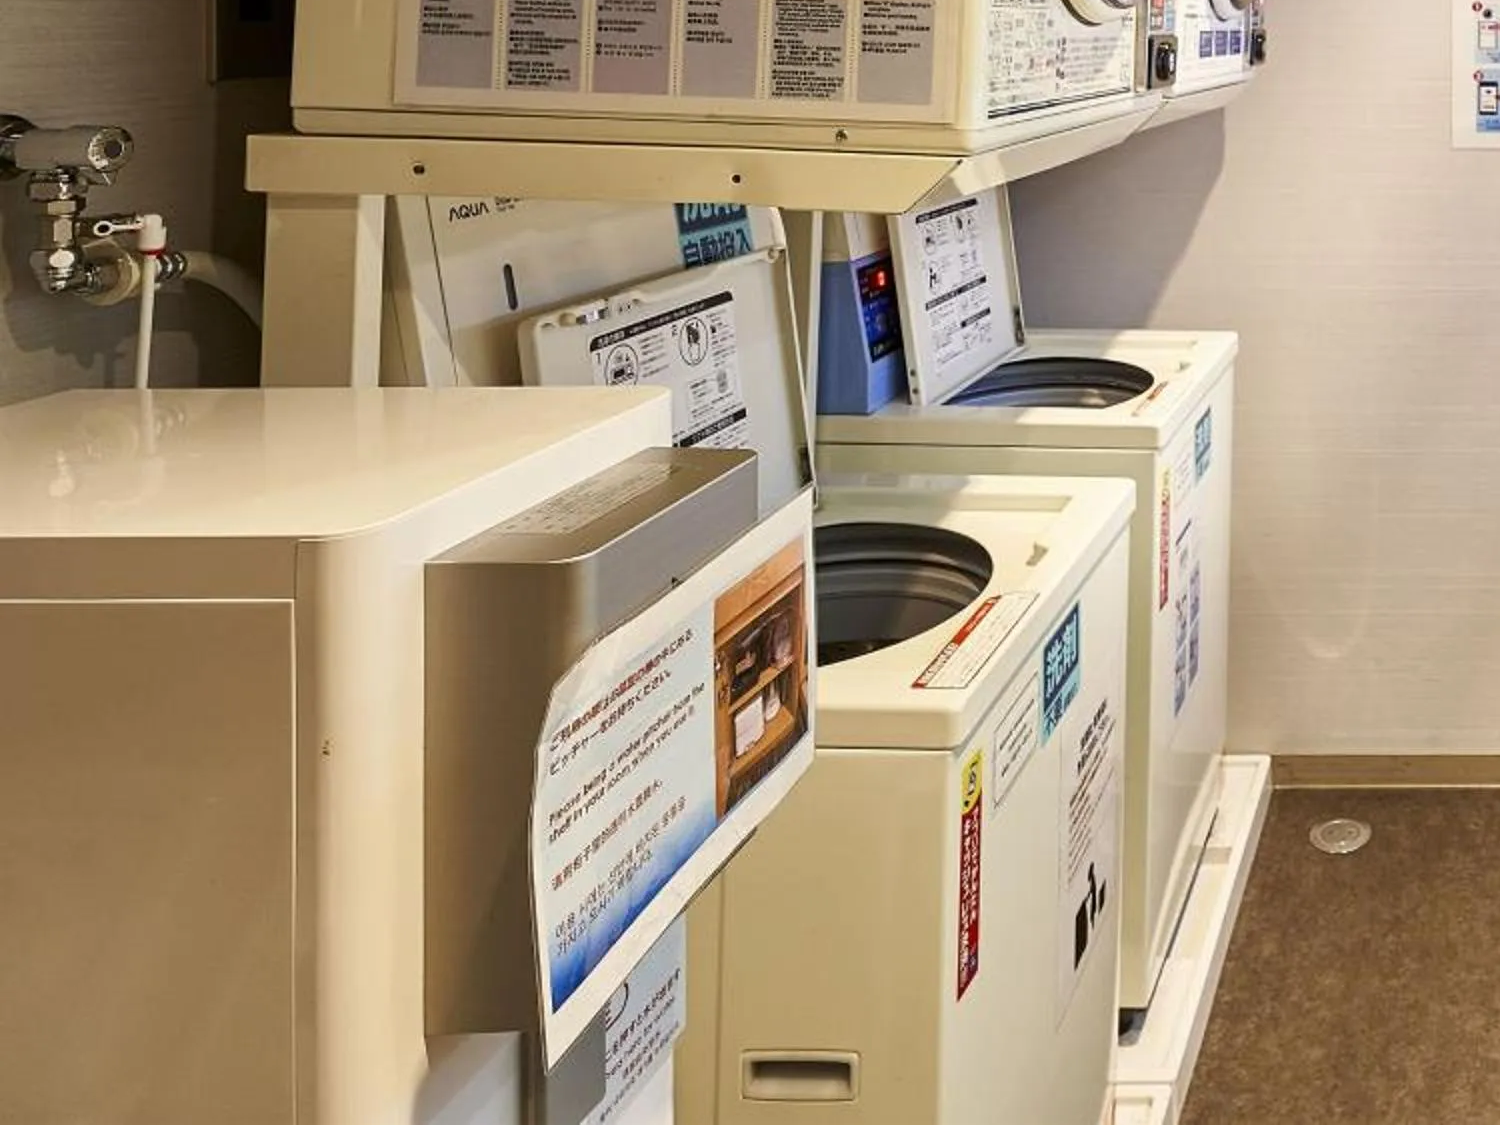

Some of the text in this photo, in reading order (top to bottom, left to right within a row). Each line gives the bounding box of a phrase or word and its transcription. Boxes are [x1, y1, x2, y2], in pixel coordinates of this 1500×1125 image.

[450, 202, 489, 222] AQUA
[682, 228, 751, 264] 自動投入
